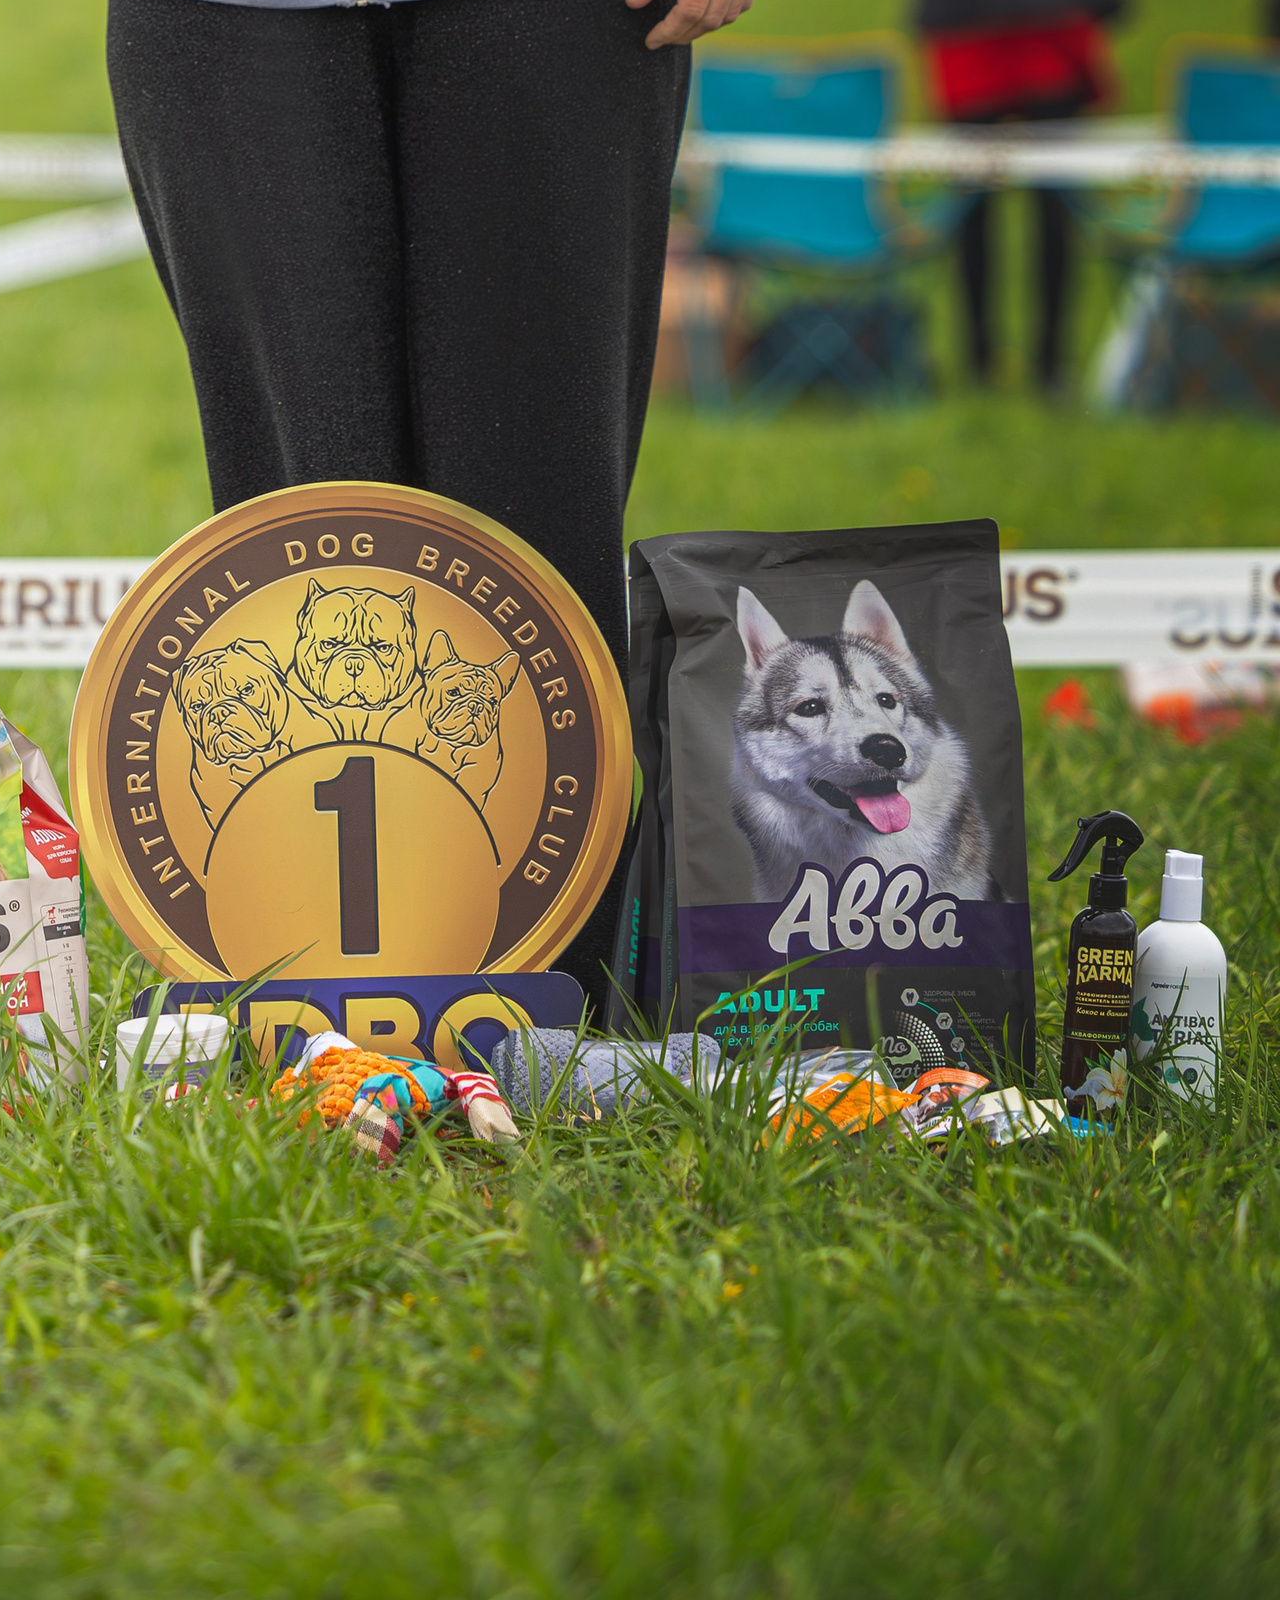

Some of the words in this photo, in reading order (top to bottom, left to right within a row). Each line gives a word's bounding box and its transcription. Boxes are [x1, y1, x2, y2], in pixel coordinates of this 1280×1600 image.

[127, 569, 251, 900] INTERNATIONAL
[284, 532, 376, 566] DOG
[416, 544, 576, 731] BREEDERS
[522, 773, 579, 887] CLUB
[314, 755, 380, 956] 1
[1077, 946, 1134, 966] GREEN
[1076, 963, 1133, 988] KARMA
[713, 988, 826, 1014] ADULT
[1076, 1006, 1099, 1016] Кокос
[803, 1020, 840, 1032] собак
[1070, 1030, 1120, 1040] АКВАФОРМУЛА
